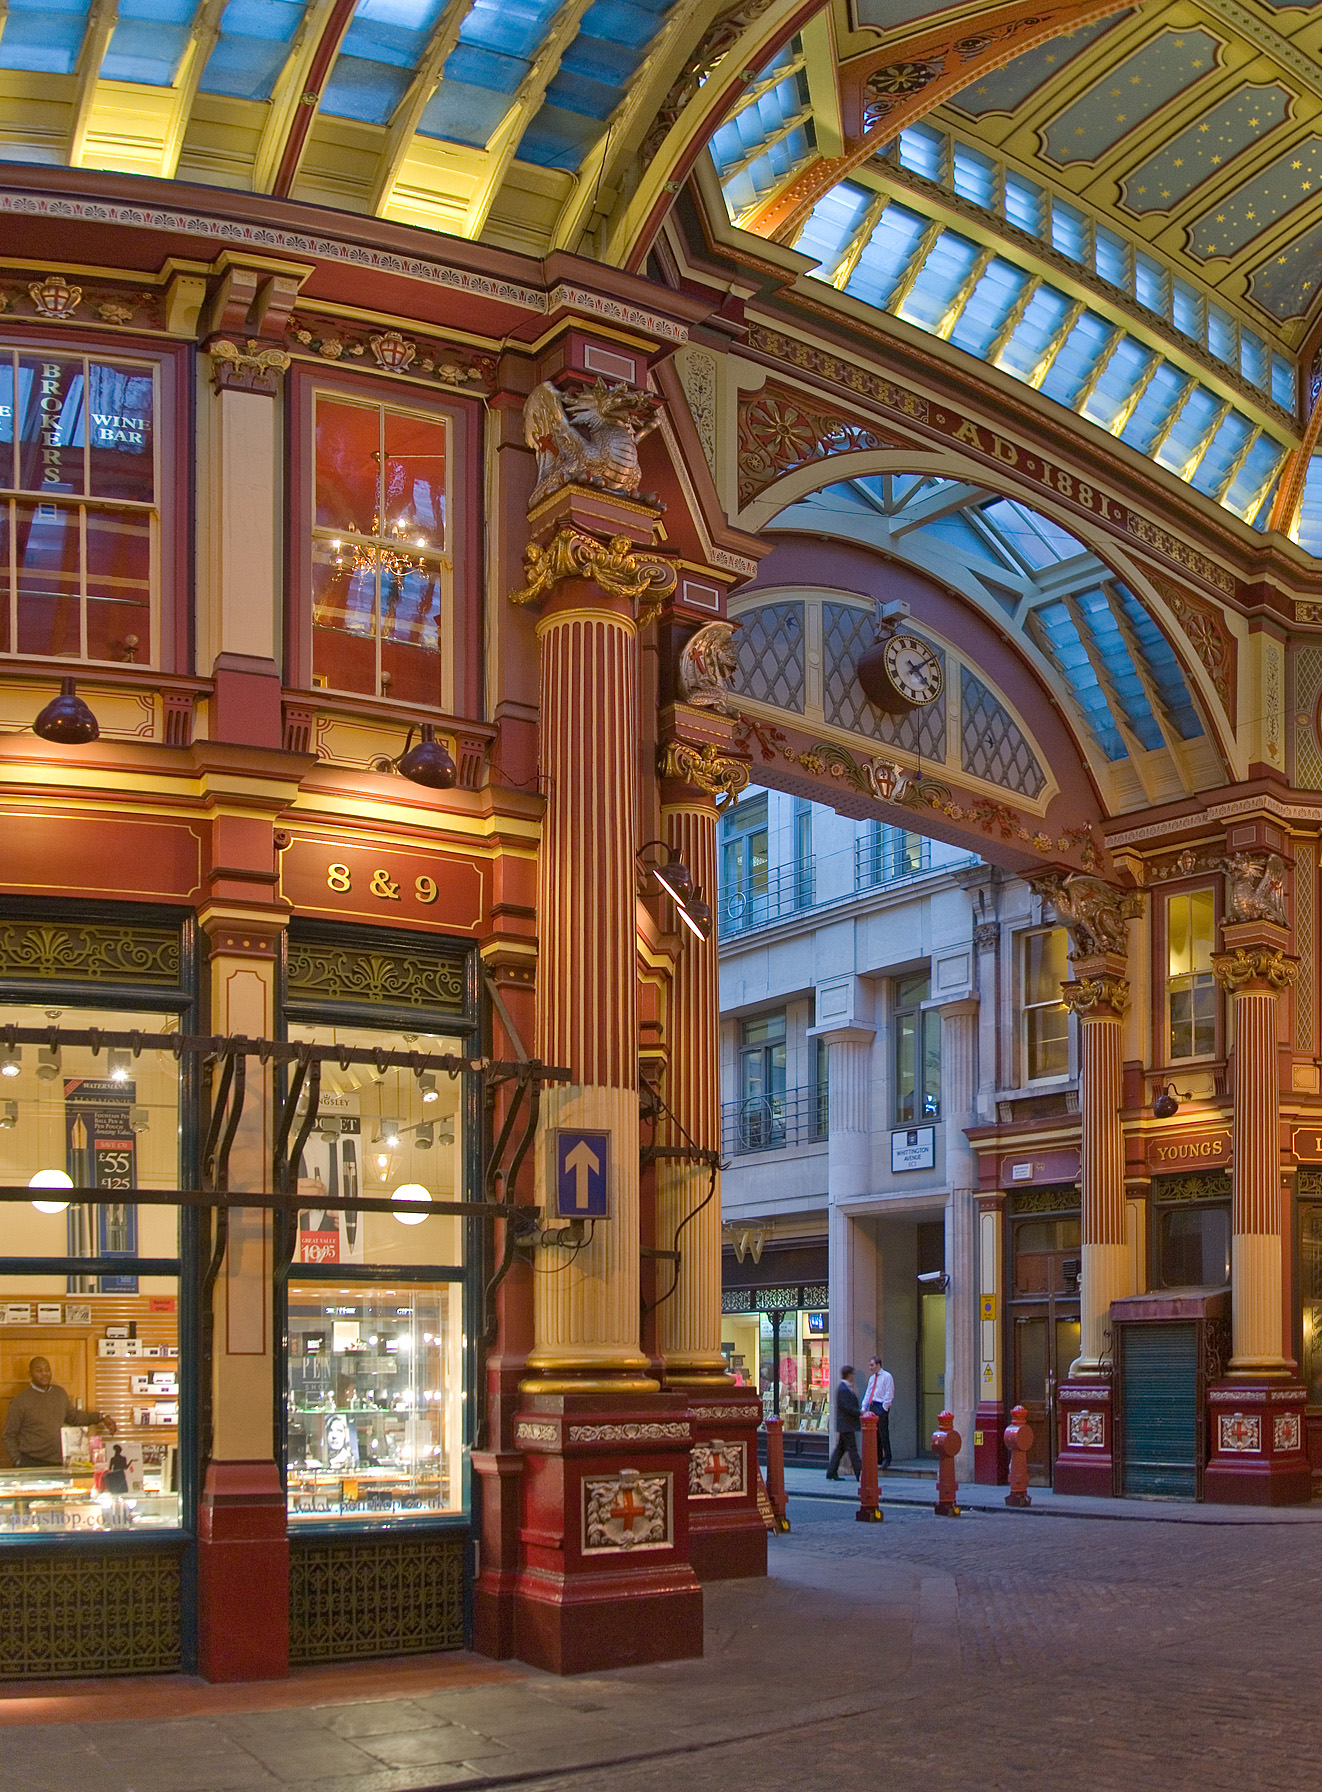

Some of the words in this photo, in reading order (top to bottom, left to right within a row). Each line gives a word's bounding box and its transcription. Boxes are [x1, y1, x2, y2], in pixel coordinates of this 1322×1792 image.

[40, 363, 63, 483] BROKERS
[91, 413, 151, 431] WINE
[99, 428, 143, 444] BAR
[952, 418, 1019, 466] AD
[1041, 461, 1111, 520] 1881
[327, 863, 351, 893] 8
[369, 869, 400, 900] &
[415, 875, 438, 904] 9
[896, 1147, 930, 1156] WHITTINGTON
[903, 1154, 922, 1162] AVENUE
[1157, 1140, 1223, 1161] YOUNGS
[98, 1152, 130, 1173] £55
[294, 1495, 444, 1516] www.penshop.co.uk
